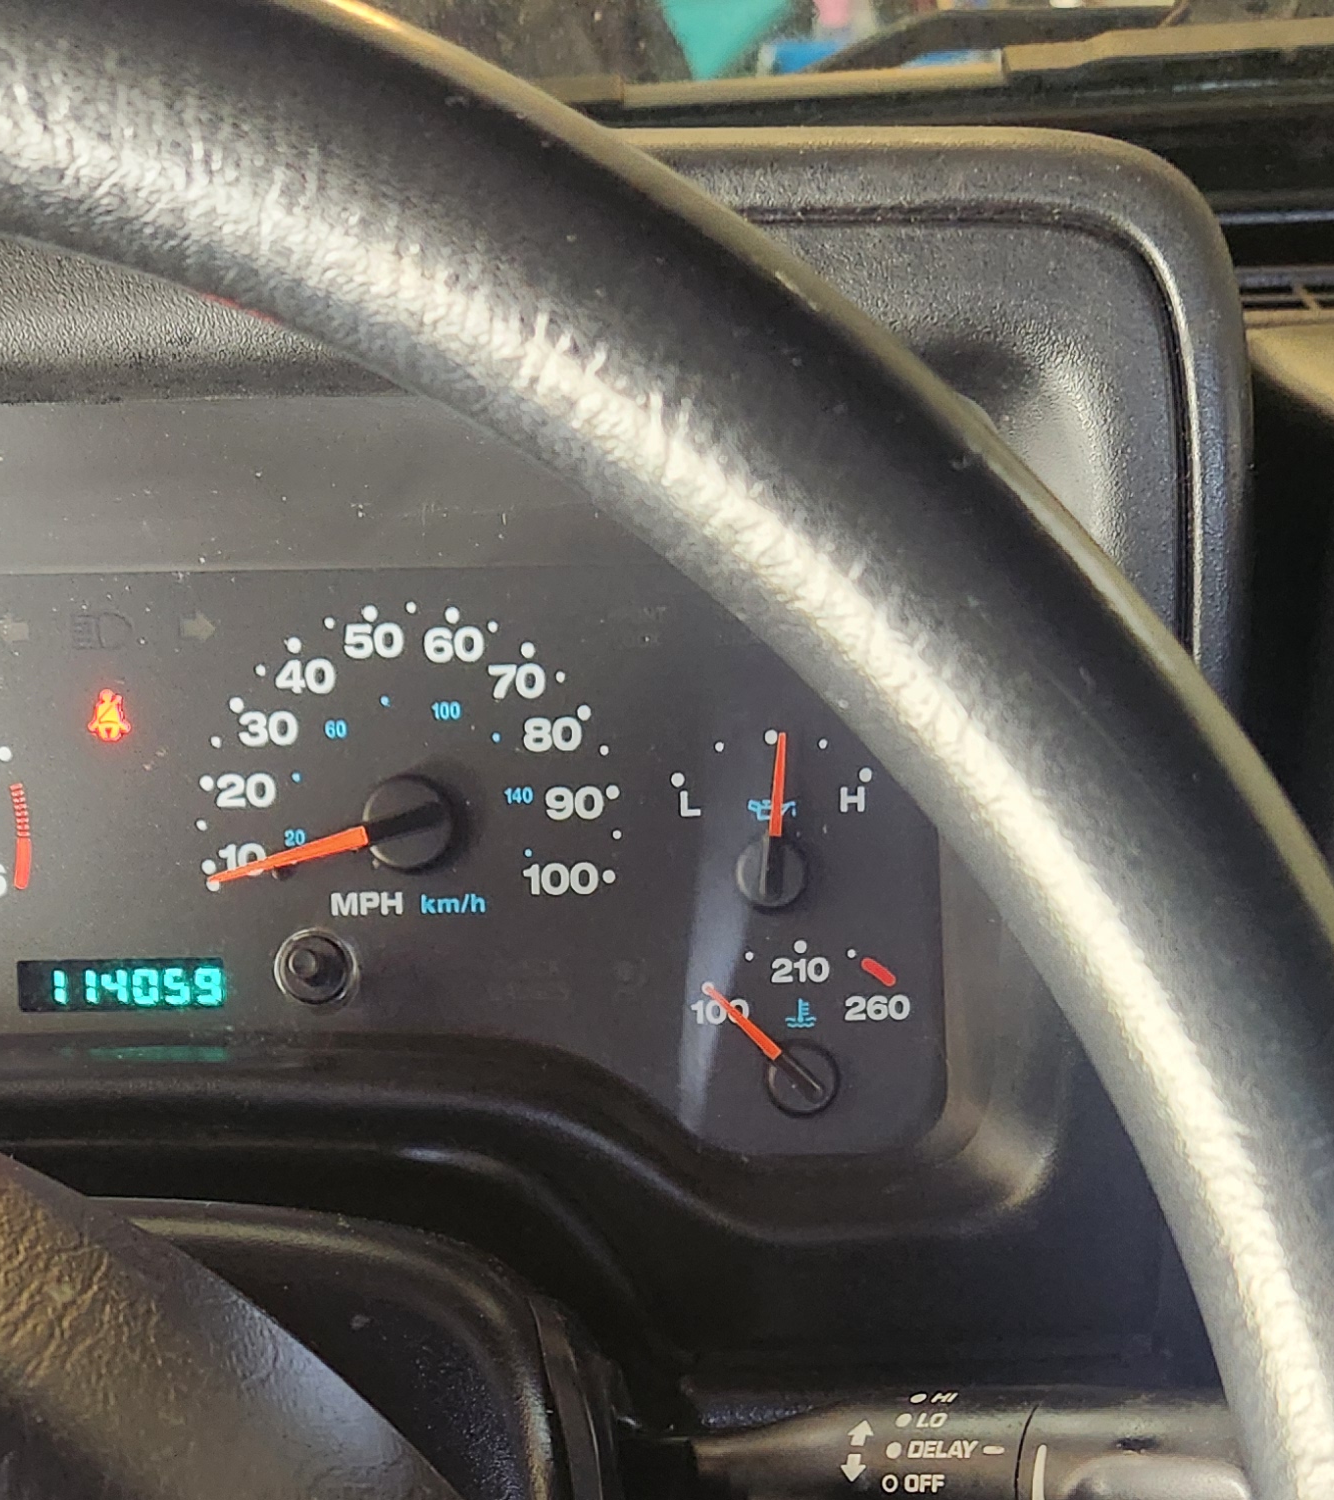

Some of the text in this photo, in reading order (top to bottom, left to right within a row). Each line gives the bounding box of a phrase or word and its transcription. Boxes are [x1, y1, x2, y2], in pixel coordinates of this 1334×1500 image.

[343, 623, 403, 659] 50
[423, 626, 484, 663] 60
[275, 658, 336, 694] 40
[487, 663, 545, 699] 70
[431, 701, 461, 721] 100
[238, 711, 298, 747] 30
[324, 719, 347, 741] 60
[523, 717, 583, 752] 80
[216, 773, 277, 808] 20
[504, 786, 534, 806] 140
[545, 786, 605, 821] 90
[839, 787, 865, 812] H
[679, 791, 701, 817] L
[284, 828, 306, 847] 20
[218, 842, 267, 876] 10
[522, 862, 599, 896] 100
[330, 891, 486, 916] MPH km/h
[771, 957, 830, 984] 210
[844, 995, 911, 1021] 260
[930, 1392, 959, 1404] HI
[916, 1412, 948, 1429] LO
[907, 1440, 979, 1459] DELAY
[903, 1473, 946, 1493] OFF
